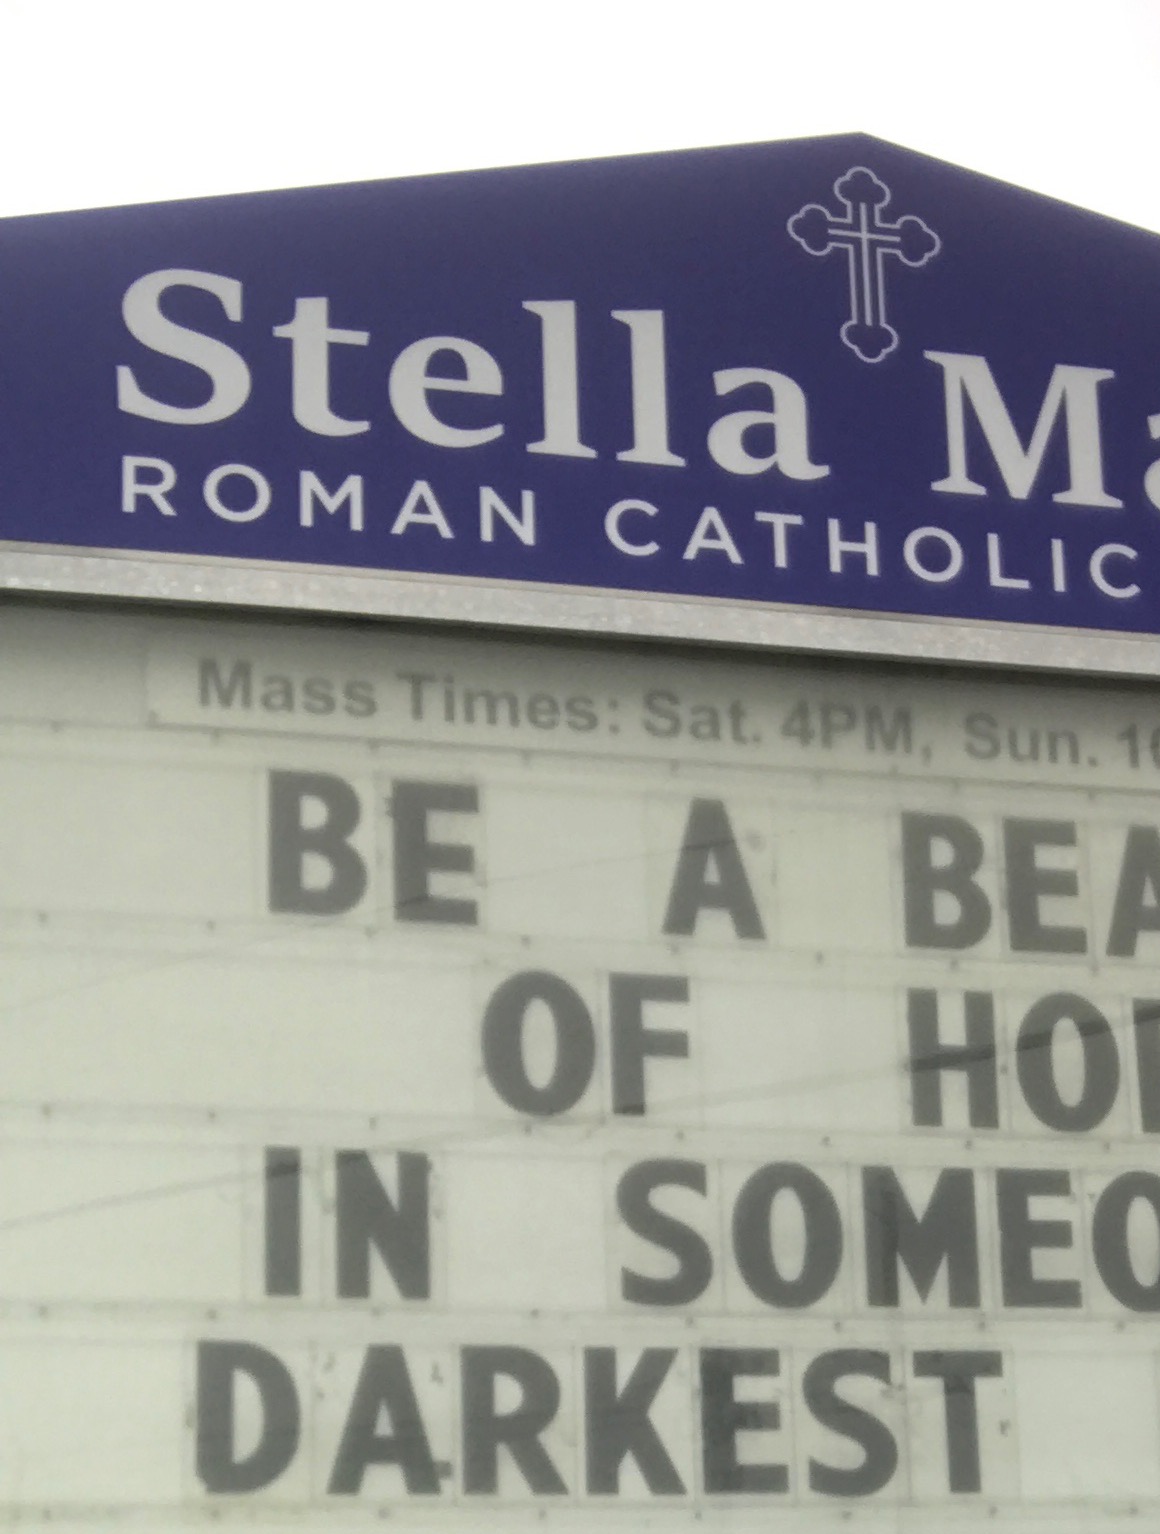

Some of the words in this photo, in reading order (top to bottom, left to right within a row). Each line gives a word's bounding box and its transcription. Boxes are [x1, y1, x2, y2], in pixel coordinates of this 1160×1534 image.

[116, 268, 831, 481] Stella
[121, 454, 537, 547] ROMAN
[604, 498, 1140, 600] CATHOLIC
[200, 657, 379, 719] Mass
[396, 671, 621, 735] Times:
[641, 688, 762, 745] Sat.
[780, 700, 934, 768] 4PM,
[963, 710, 1099, 767] Sun.
[266, 768, 480, 926] BE
[662, 797, 768, 940] A
[480, 969, 690, 1117] OF
[264, 1145, 432, 1300] IN
[195, 1339, 1003, 1498] DARKEST
